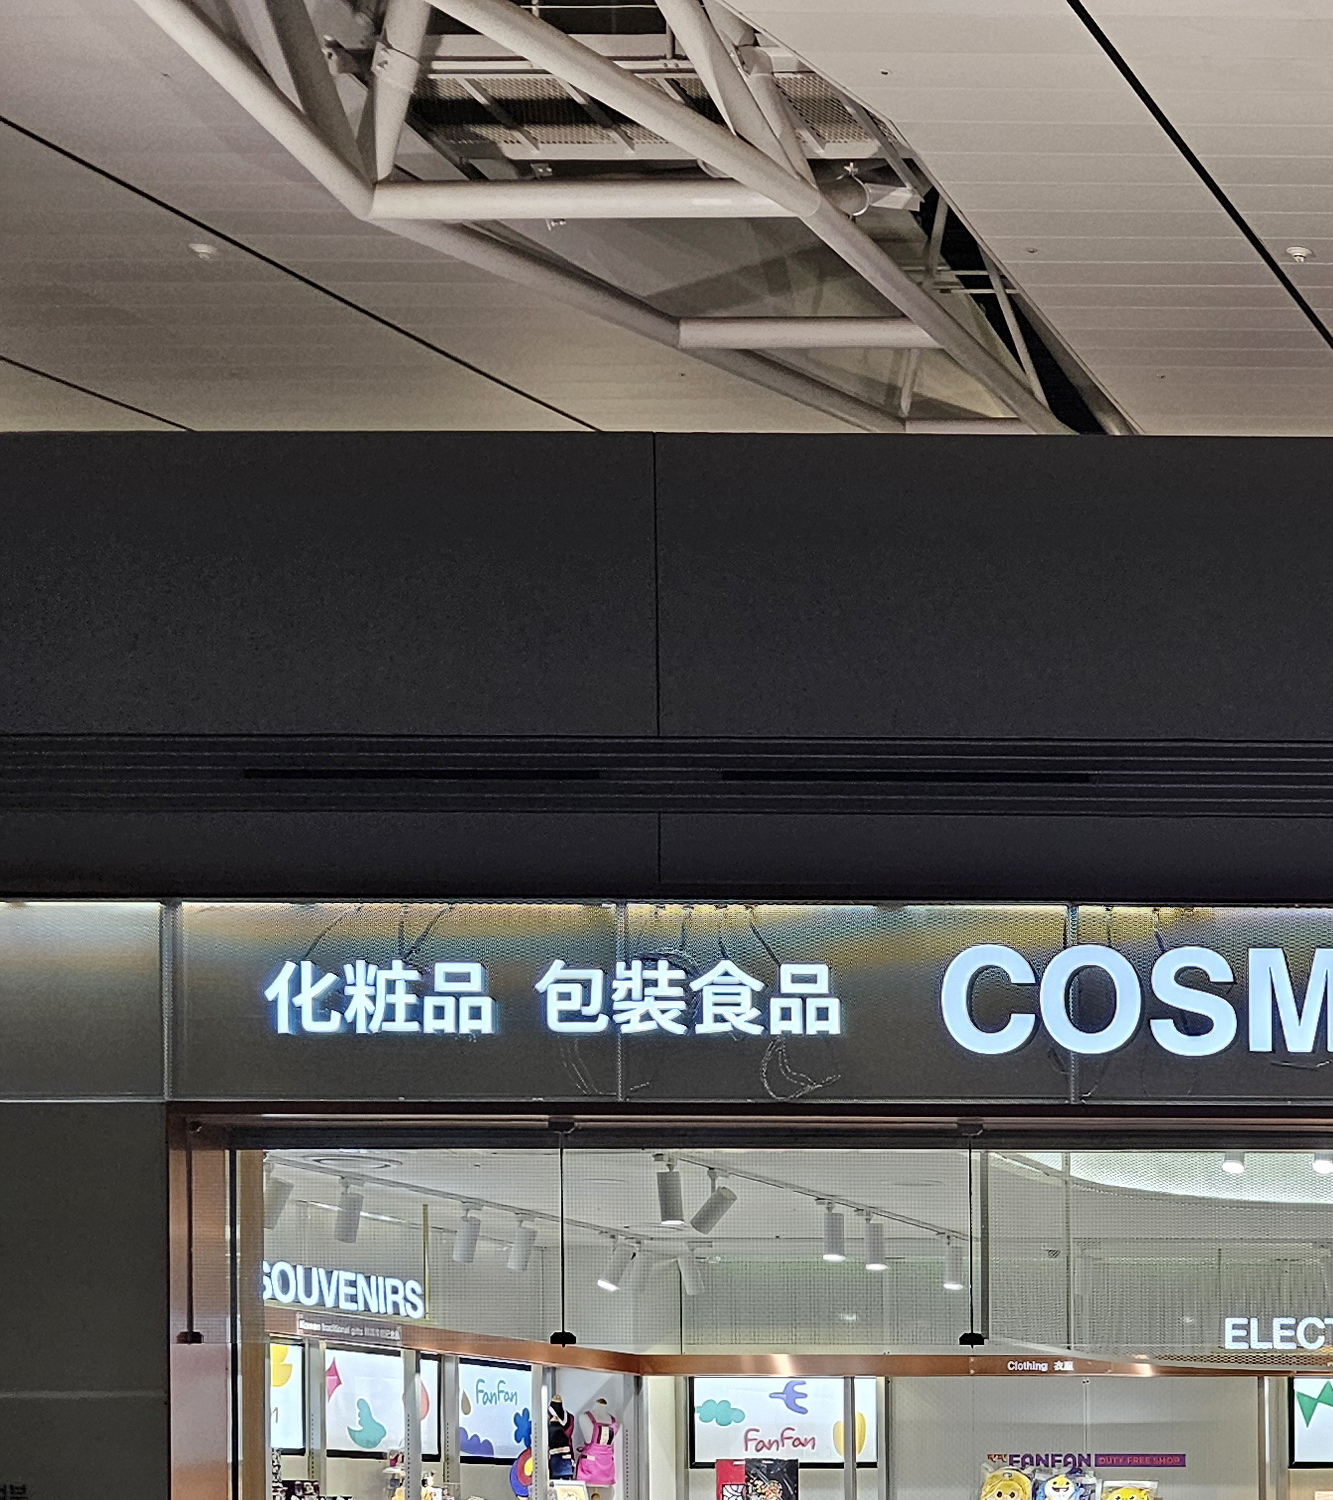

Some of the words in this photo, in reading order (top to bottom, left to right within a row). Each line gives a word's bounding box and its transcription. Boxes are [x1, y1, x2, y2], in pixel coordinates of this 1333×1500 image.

[264, 959, 495, 1037] 化粧品
[535, 959, 843, 1037] 包裝食品
[262, 1260, 425, 1320] SOUVENIRS
[1007, 1361, 1048, 1372] Clothing
[475, 1378, 518, 1406] FanFan
[744, 1427, 816, 1453] FanFan
[1008, 1453, 1092, 1468] FANFAN
[1099, 1456, 1125, 1465] DUTY
